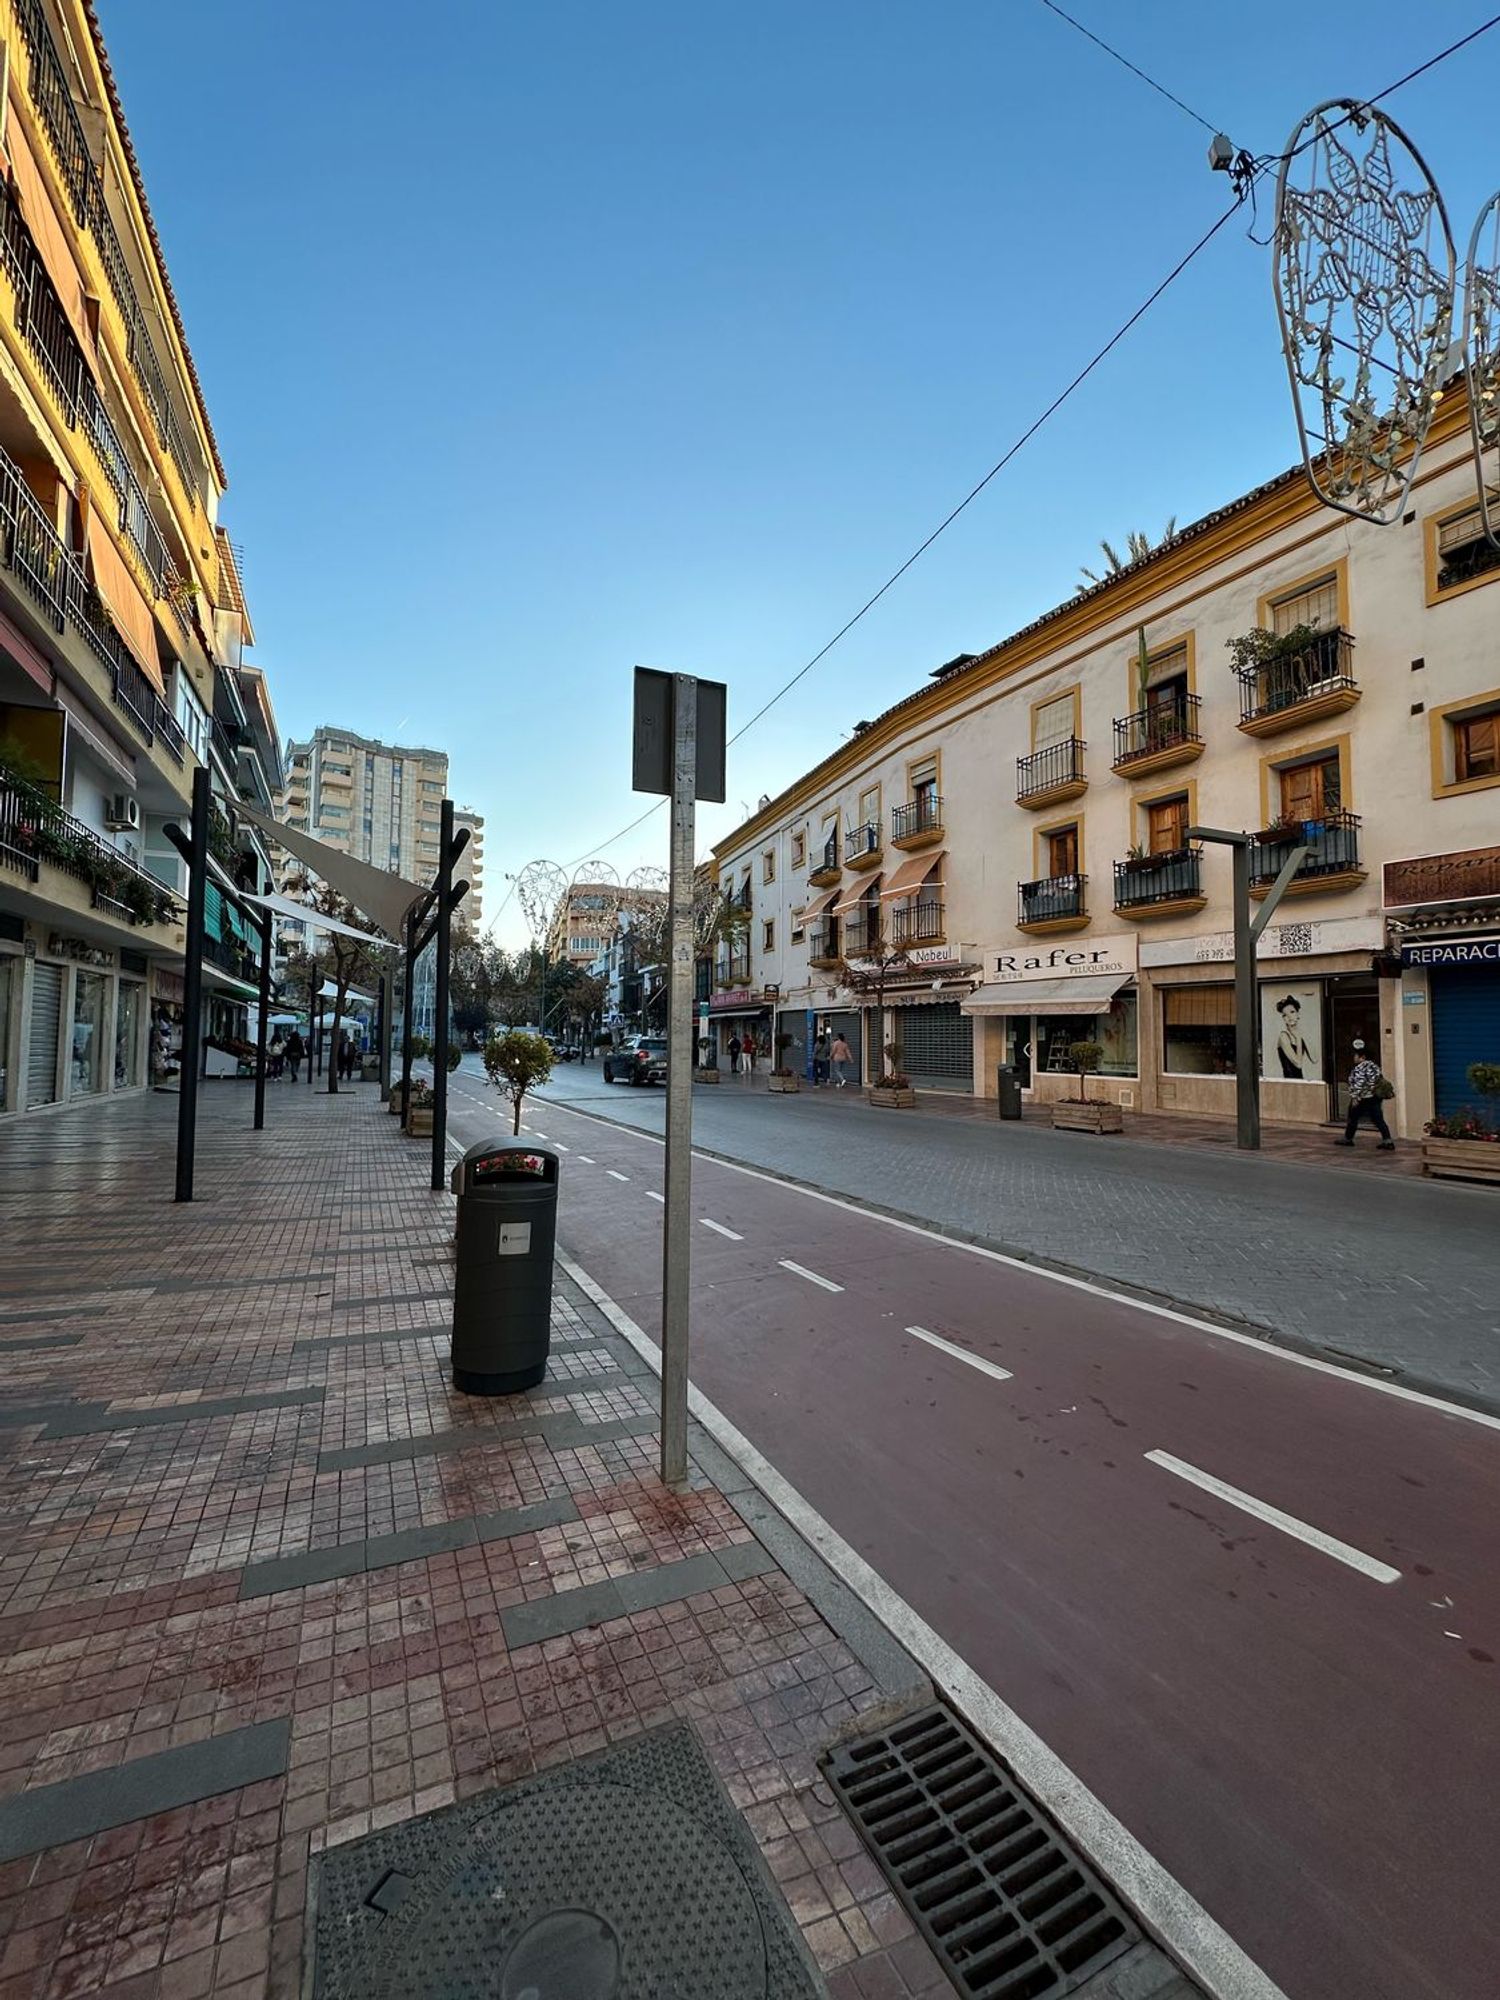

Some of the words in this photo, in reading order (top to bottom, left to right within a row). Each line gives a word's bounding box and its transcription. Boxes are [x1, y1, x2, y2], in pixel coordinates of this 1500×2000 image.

[915, 946, 953, 963] Nabeul
[993, 949, 1110, 974] Rafer
[1069, 961, 1124, 975] PELUQUEROS
